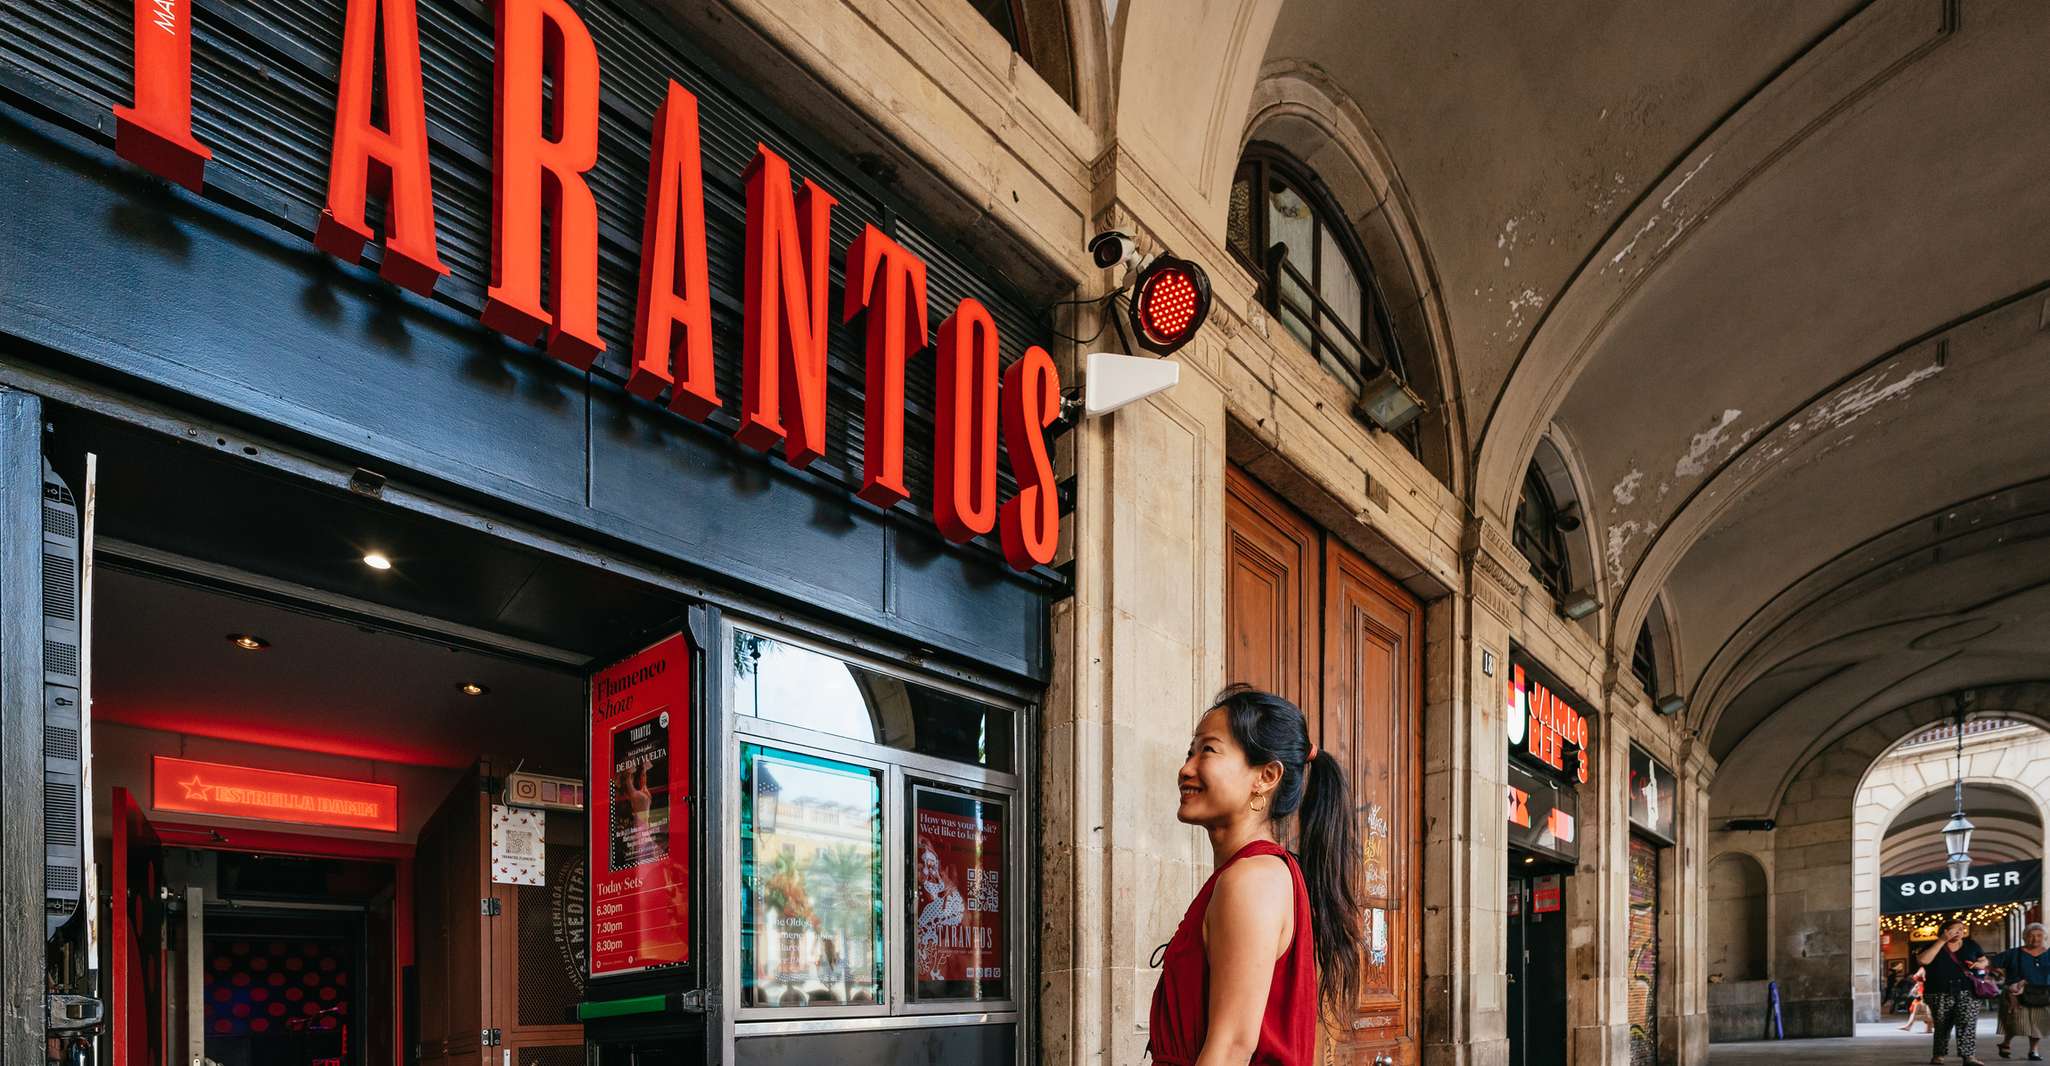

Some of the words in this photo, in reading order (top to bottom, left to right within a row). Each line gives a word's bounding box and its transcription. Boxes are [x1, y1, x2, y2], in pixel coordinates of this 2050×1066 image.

[1483, 653, 1493, 675] 18
[597, 656, 667, 702] Flamenco
[597, 694, 635, 720] Show
[1528, 681, 1588, 750] JAMBO
[1528, 714, 1564, 772] REE
[214, 785, 314, 812] ESTRELLA
[318, 797, 379, 818] DAMM
[920, 813, 939, 824] How
[940, 819, 956, 827] was
[957, 821, 977, 831] your
[920, 824, 940, 835] We'd
[941, 826, 956, 837] like
[957, 830, 966, 838] to
[596, 879, 623, 896] Today
[624, 876, 644, 890] Sets
[1900, 870, 2020, 896] SONDER
[552, 885, 565, 942] PREMIADA
[596, 903, 623, 916] 6.30pm
[596, 922, 623, 934] 7.30pm
[937, 925, 993, 948] TARANTOS
[596, 939, 623, 952] 8.30pm
